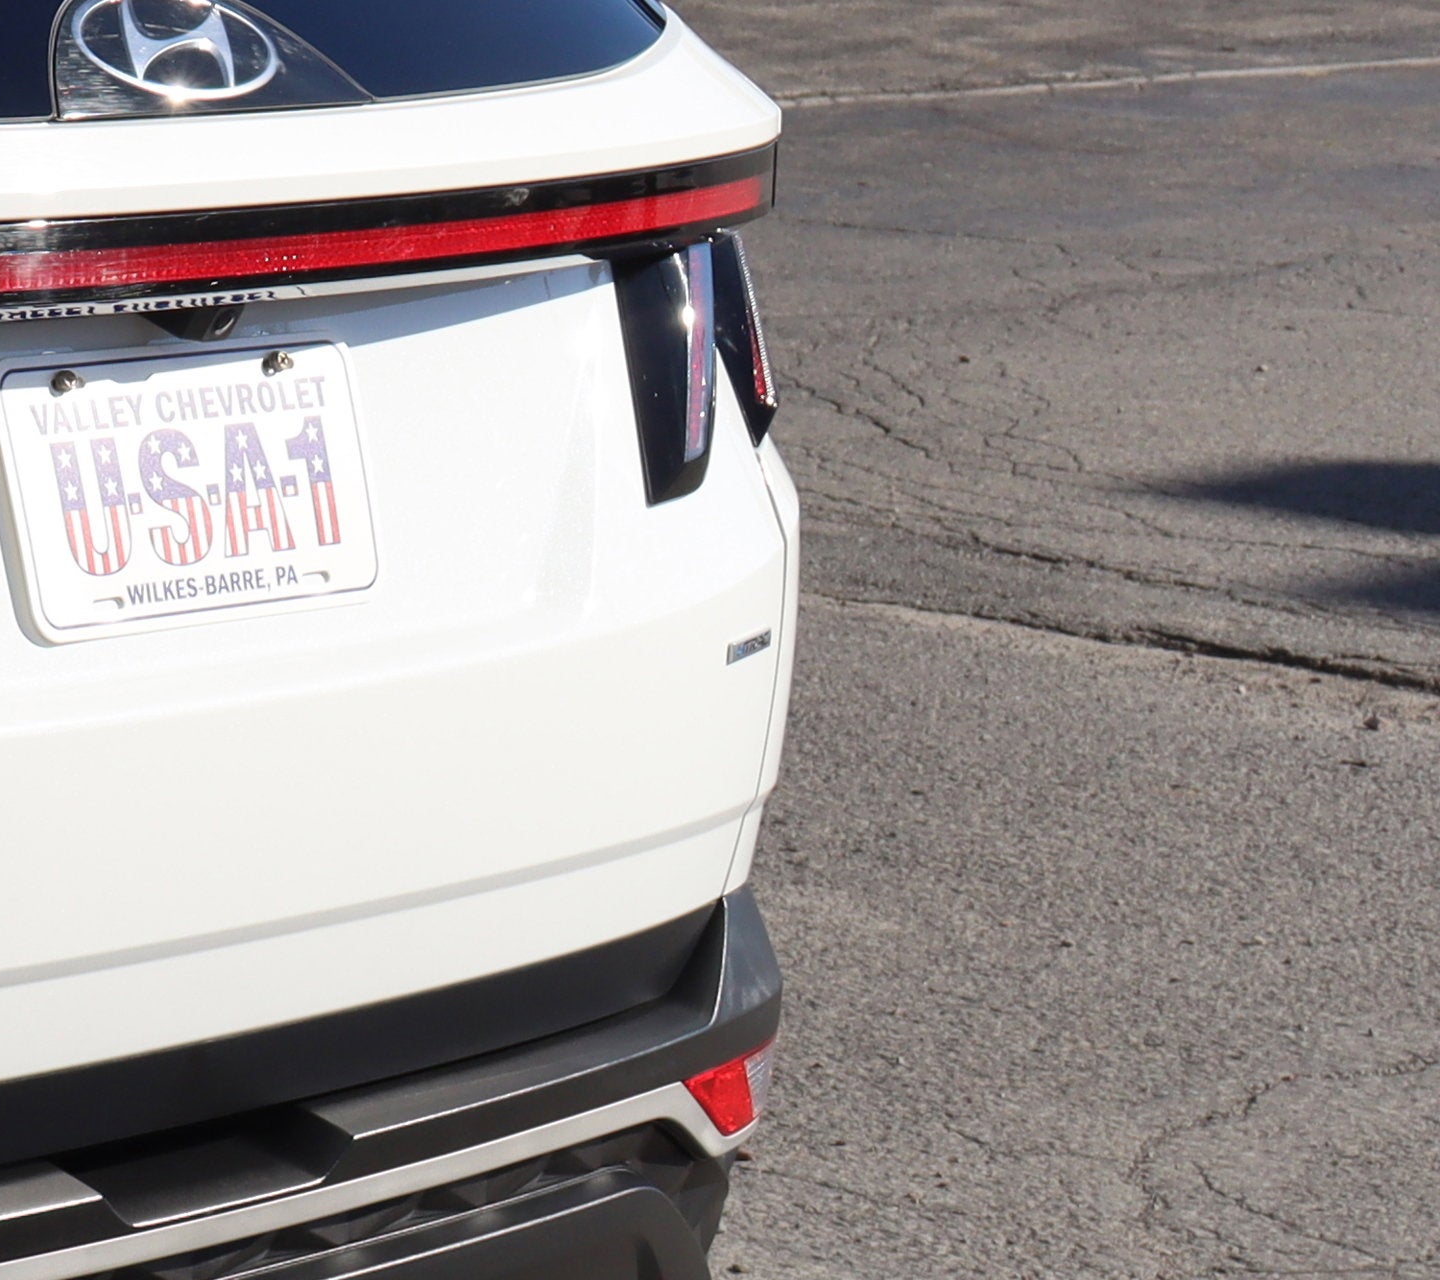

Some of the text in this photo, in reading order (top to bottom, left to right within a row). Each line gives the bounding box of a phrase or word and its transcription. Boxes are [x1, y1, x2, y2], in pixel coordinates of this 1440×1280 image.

[30, 375, 328, 436] VALLEY CHEVROLET
[276, 566, 299, 586] PA
